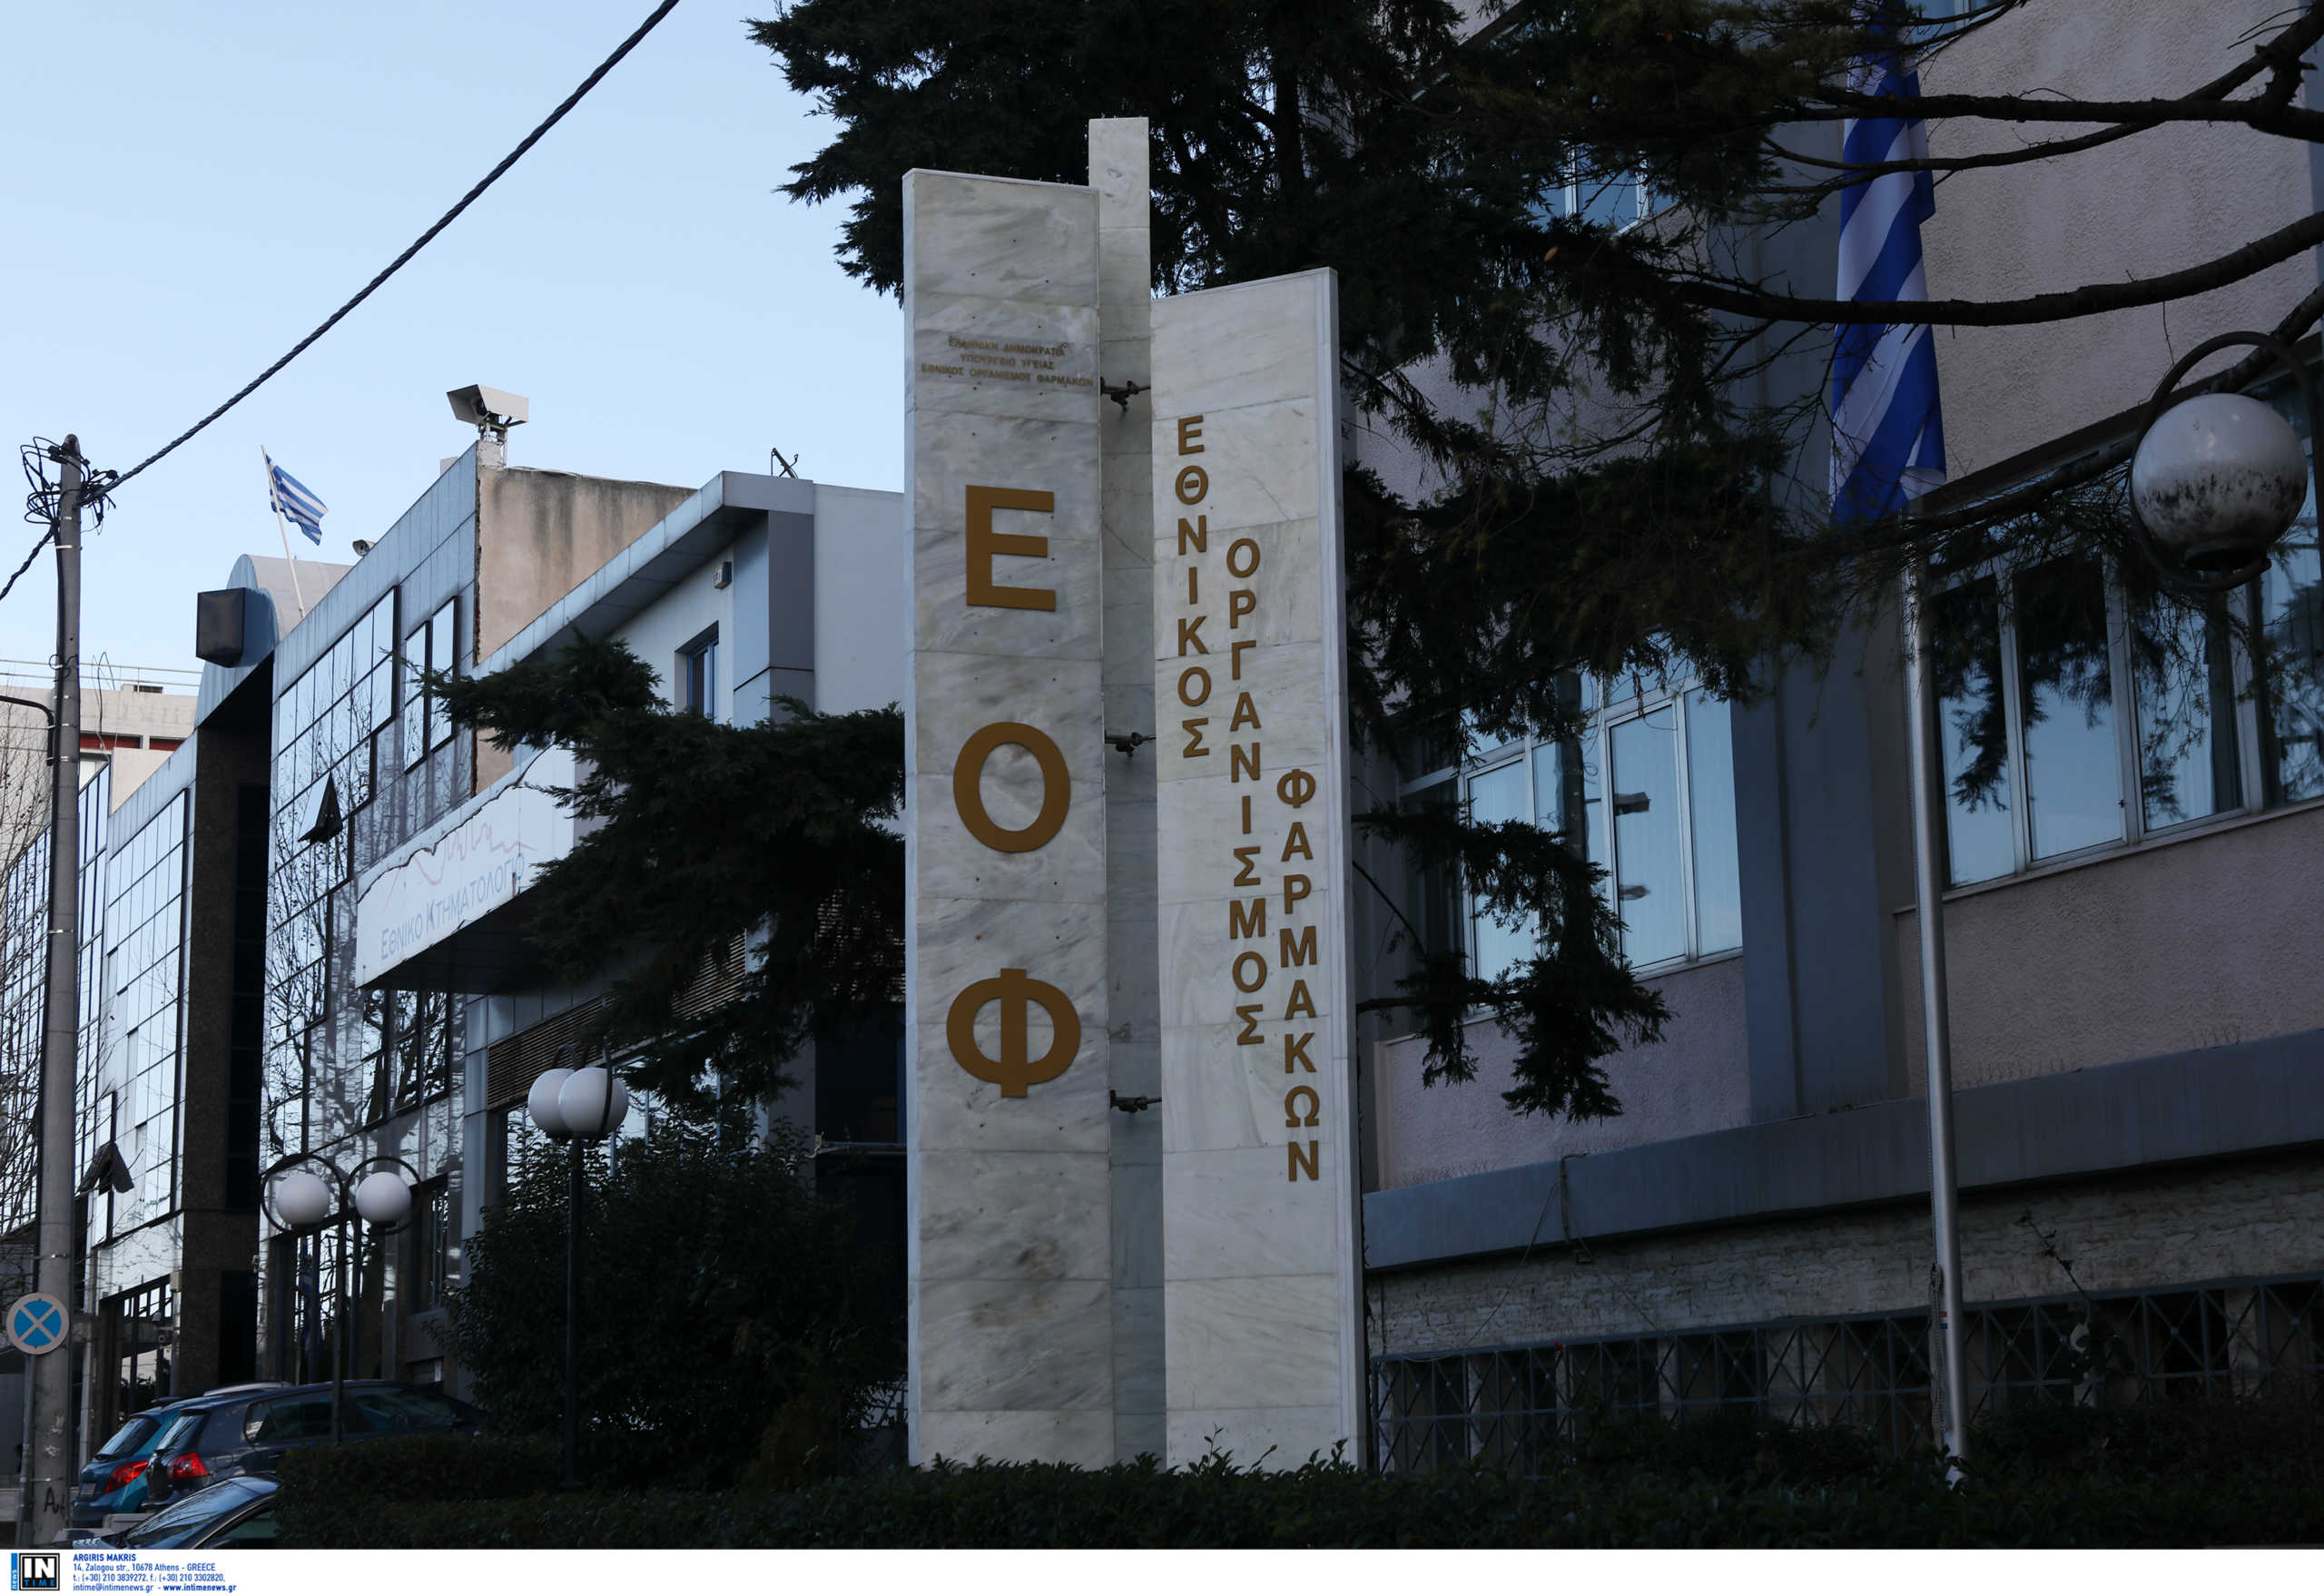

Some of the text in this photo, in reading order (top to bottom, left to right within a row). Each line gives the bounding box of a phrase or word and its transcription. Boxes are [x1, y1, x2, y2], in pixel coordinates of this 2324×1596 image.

[921, 363, 1095, 386] ΕΘΝΙΚΟΣ ΟΡΓΑΝΙΣΜΟΣ ΦΑΡΜΑΚΩΝ
[1021, 358, 1054, 369] ΥΓΕΙΑΣ
[1175, 414, 1212, 758] ΕΘΝΙΚΟΣ
[381, 852, 525, 961] ΕΘΝΙΚΟ ΚΤΗΜΑΤΟΛΟΓΙΟ
[946, 485, 1081, 1098] ΕΟΦ
[1226, 537, 1267, 1046] ΟΡΓΑΝΙΣΜΟΣ
[1276, 768, 1320, 1182] ΦΑΡΜΑΚΩΝ
